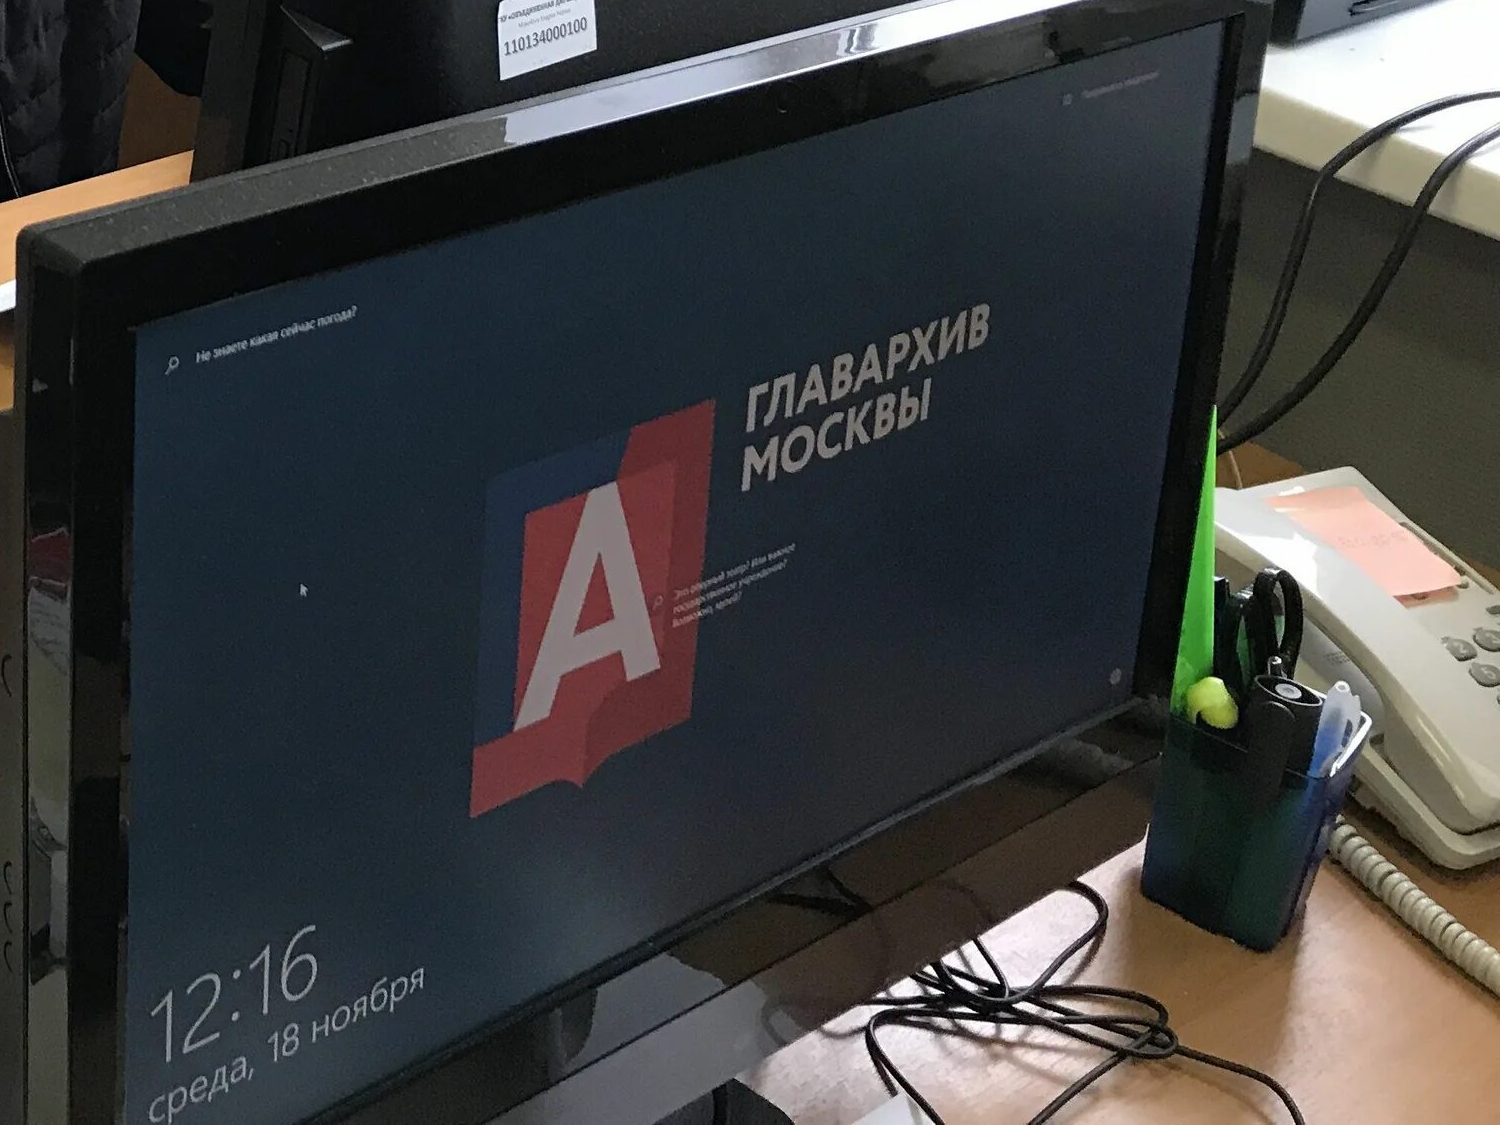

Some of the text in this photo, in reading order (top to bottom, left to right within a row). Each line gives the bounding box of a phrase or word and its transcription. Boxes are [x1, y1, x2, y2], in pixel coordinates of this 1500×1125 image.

[504, 16, 588, 56] 110134000100
[196, 349, 211, 363] Не
[249, 330, 279, 348] какая
[280, 320, 316, 339] сейчас
[317, 305, 358, 328] погода?
[745, 303, 991, 433] ГЛАВАРХИВ
[741, 377, 932, 492] МОСКВЫ
[149, 967, 425, 1124] среда, 18 ноября
[150, 925, 318, 1063] 12:16
